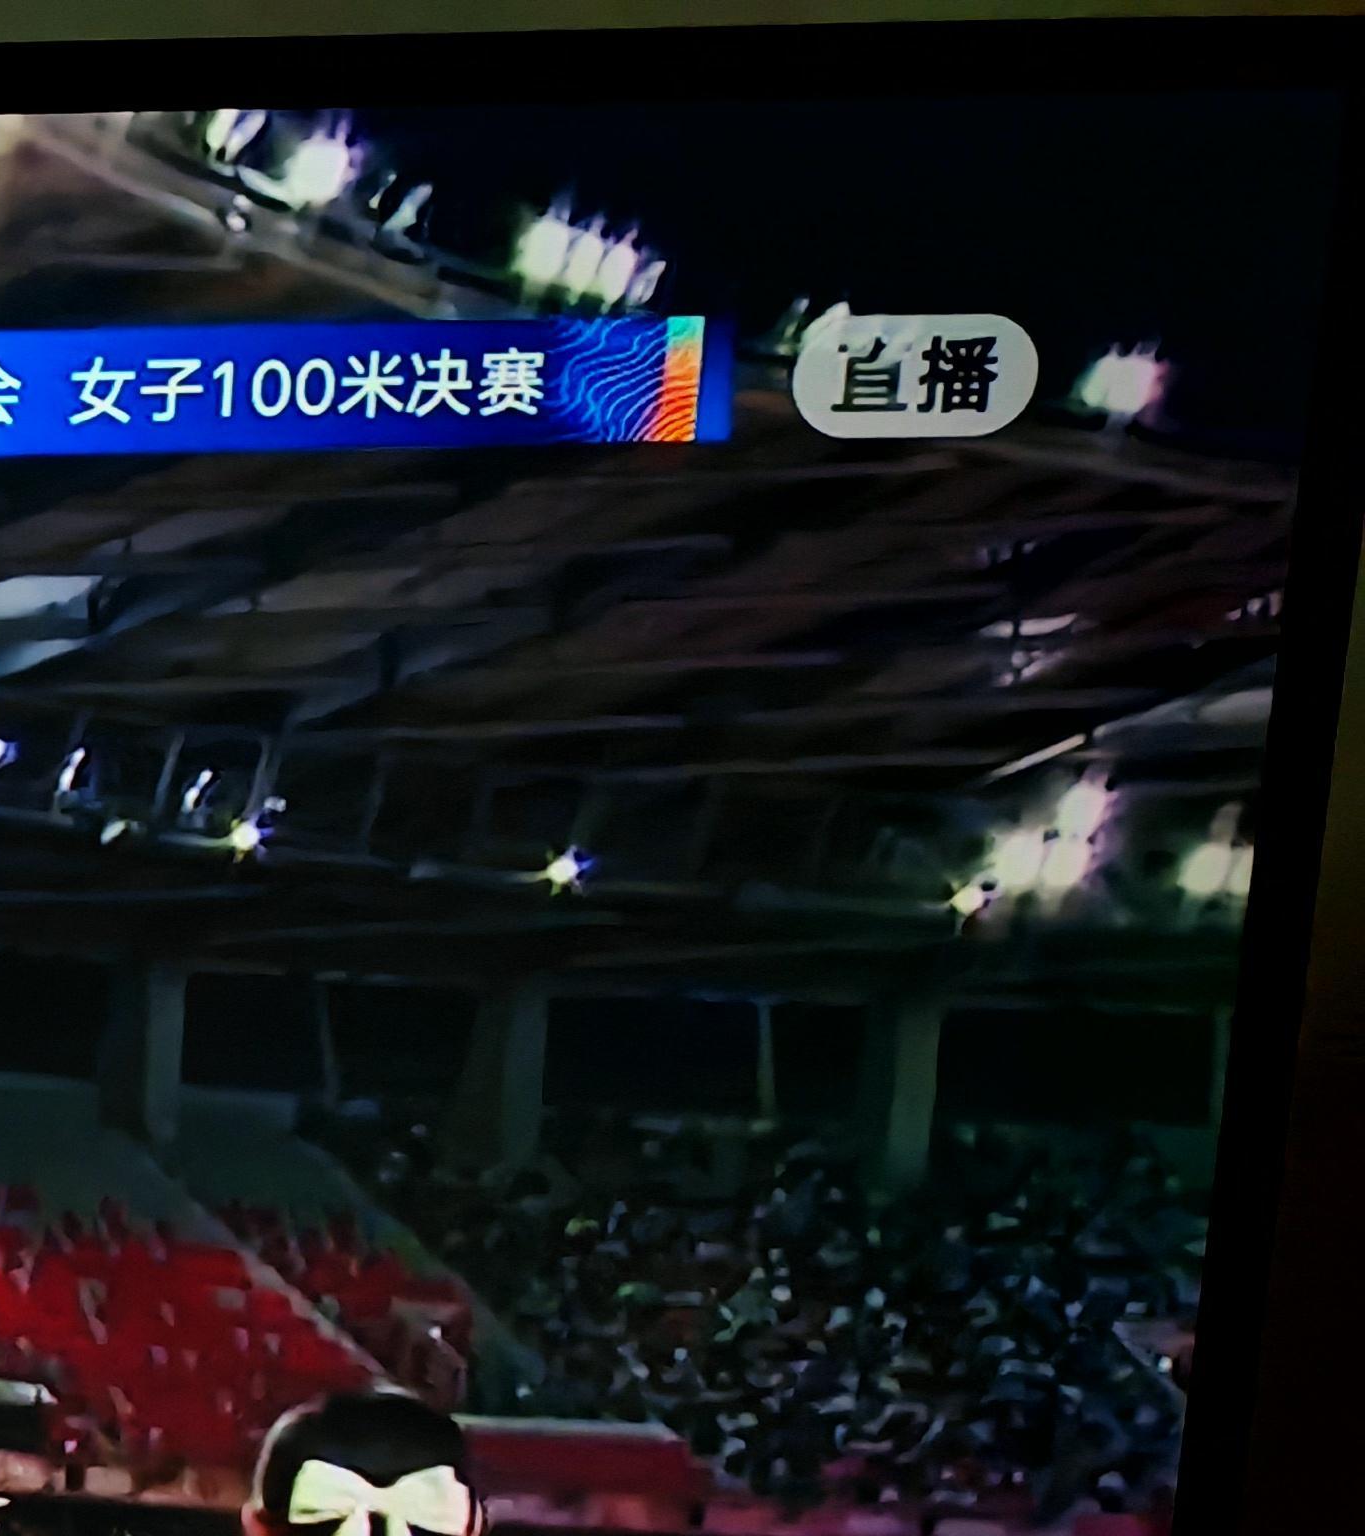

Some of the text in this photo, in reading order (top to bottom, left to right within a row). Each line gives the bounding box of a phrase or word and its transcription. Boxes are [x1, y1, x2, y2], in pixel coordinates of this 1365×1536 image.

[68, 346, 547, 426] 女子100米决赛
[830, 335, 999, 413] 直播
